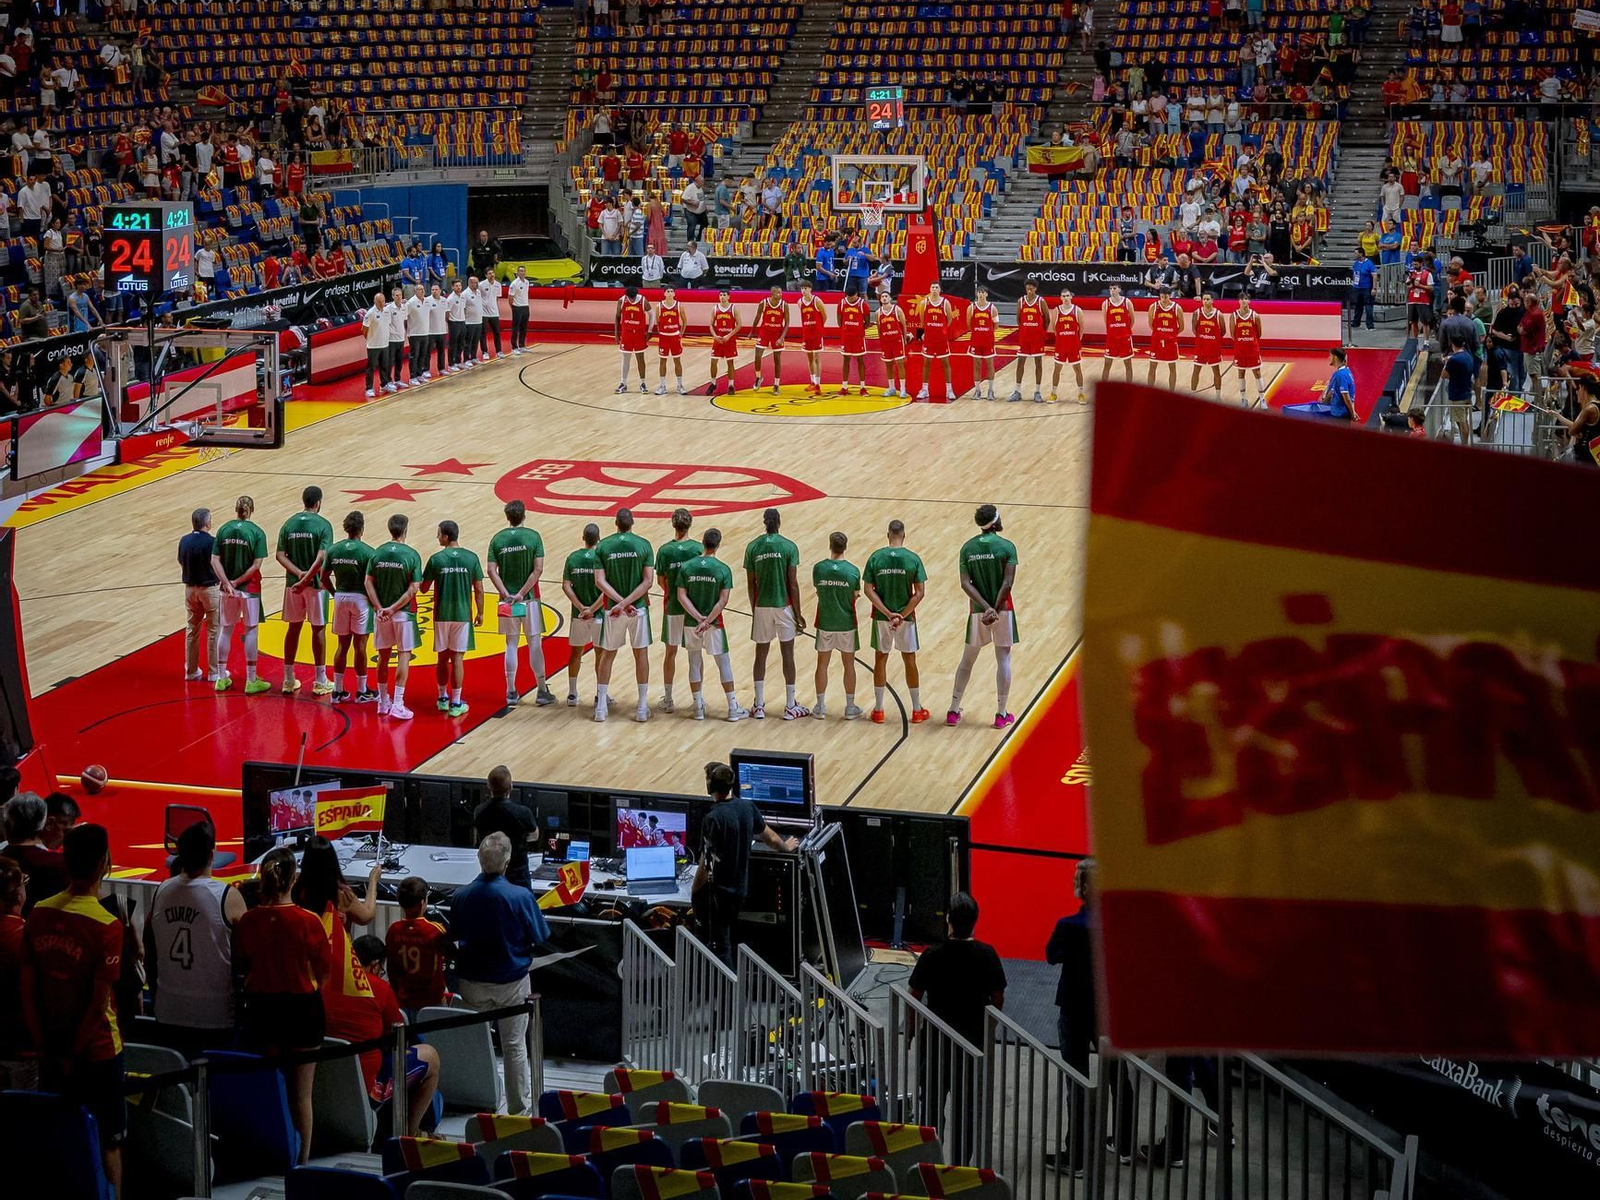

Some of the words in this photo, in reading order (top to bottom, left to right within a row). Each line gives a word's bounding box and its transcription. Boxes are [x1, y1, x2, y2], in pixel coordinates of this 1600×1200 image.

[870, 90, 891, 99] 4:21
[870, 103, 893, 120] 24
[112, 213, 151, 230] 4:21
[167, 208, 189, 228] 4:21
[111, 239, 154, 273] 24
[166, 234, 191, 272] 24
[117, 282, 149, 291] LOTUS
[170, 277, 188, 289] LOTUS
[1027, 270, 1075, 282] endesa
[1100, 272, 1139, 284] CaixaBank
[325, 284, 350, 298] endesa
[47, 343, 84, 362] endesa
[156, 434, 175, 448] renfe
[318, 802, 371, 828] ESPAÑA
[164, 905, 200, 924] CURRY
[170, 927, 194, 970] 4
[398, 944, 421, 974] 19
[1543, 1124, 1593, 1161] despierta
